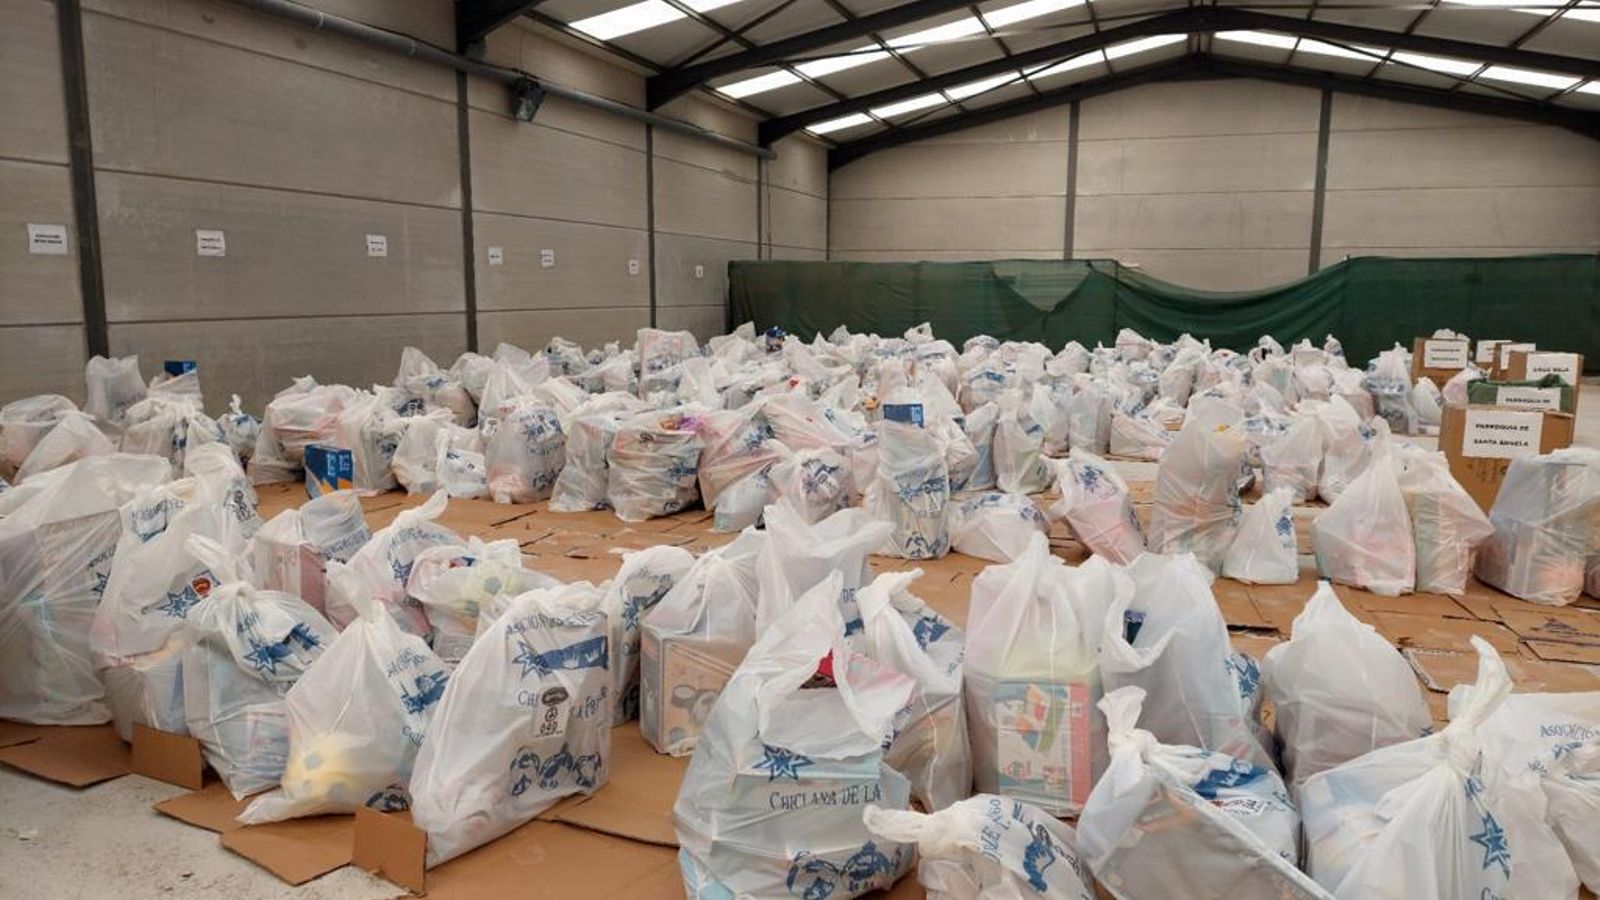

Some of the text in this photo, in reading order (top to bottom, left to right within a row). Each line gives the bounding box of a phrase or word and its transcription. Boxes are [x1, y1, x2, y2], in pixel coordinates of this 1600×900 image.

[1475, 423, 1518, 431] PARROQUIA
[841, 784, 860, 806] DE
[863, 783, 882, 804] LA
